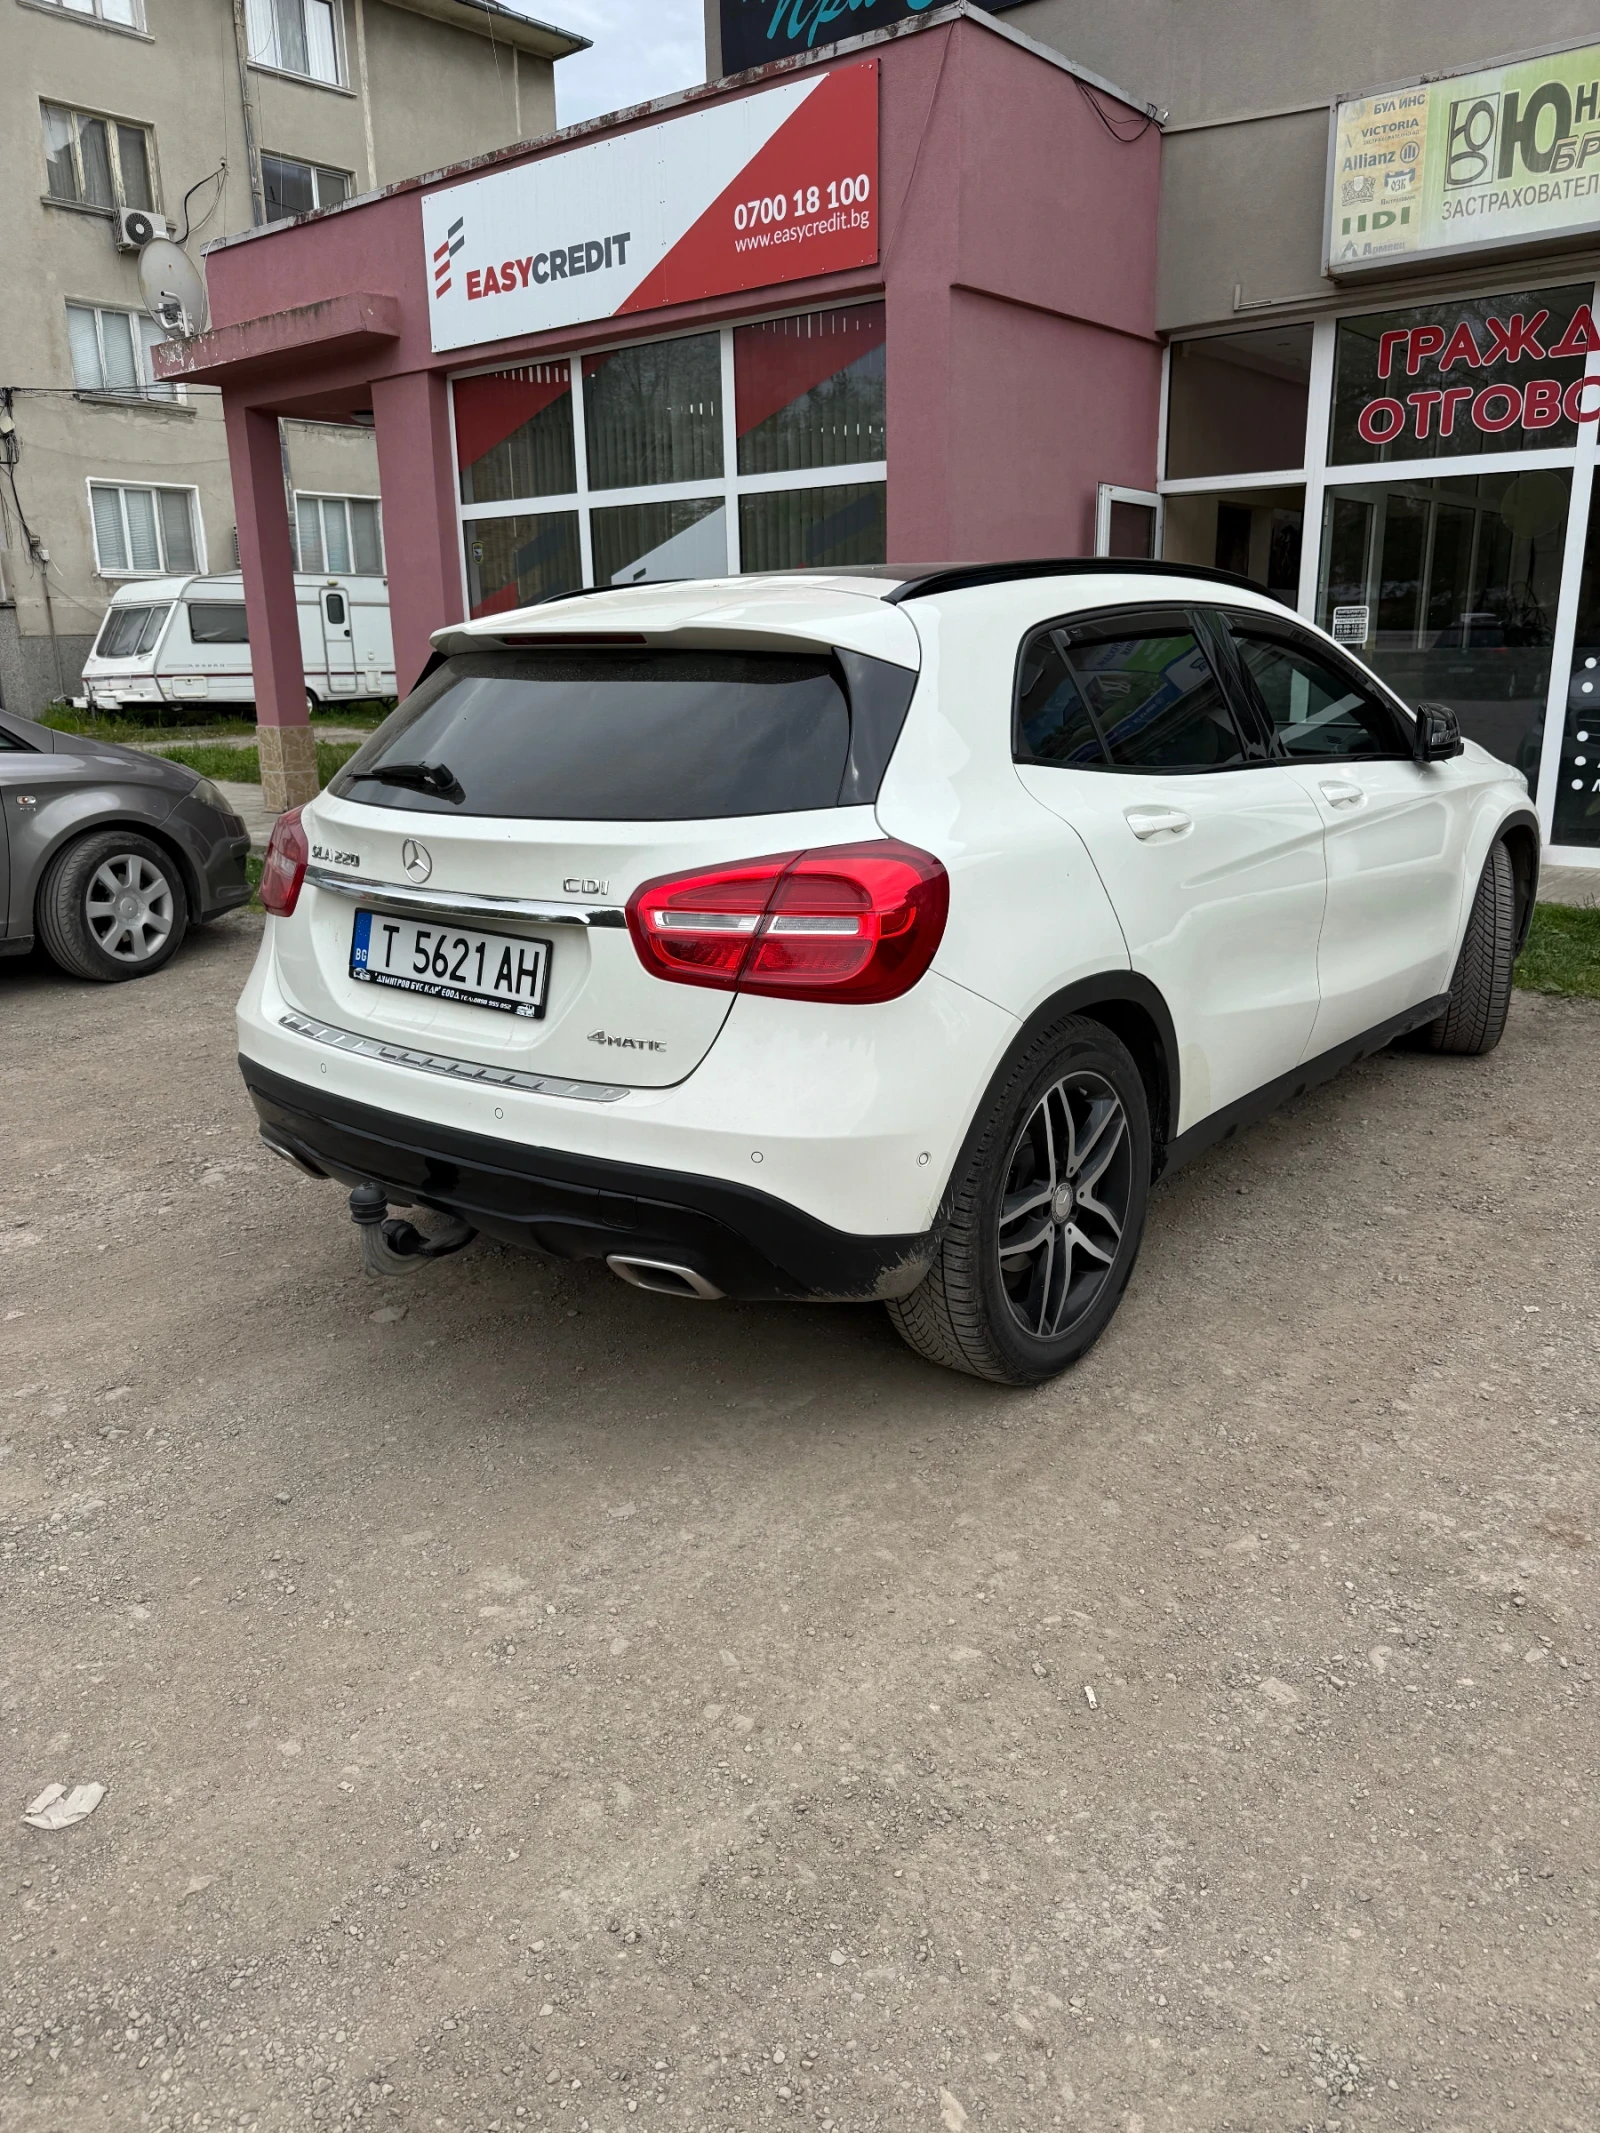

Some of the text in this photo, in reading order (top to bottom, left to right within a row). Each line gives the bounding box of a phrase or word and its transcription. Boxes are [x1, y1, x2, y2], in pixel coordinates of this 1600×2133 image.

[1373, 101, 1397, 116] БУЛ
[1399, 94, 1427, 110] ИНС
[1361, 117, 1421, 139] VICTORIA
[1342, 150, 1397, 173] Allianz
[734, 173, 870, 230] 0700 18 100
[1441, 173, 1600, 221] ЗАСТРАХОВАТЕЛ
[734, 209, 870, 254] www.easycredit.bg
[466, 231, 631, 301] EASYCREDIT
[563, 877, 610, 896] CDI
[355, 947, 368, 962] BG
[383, 924, 540, 997] T 5621 AH
[587, 1029, 667, 1053] 4MATIC
